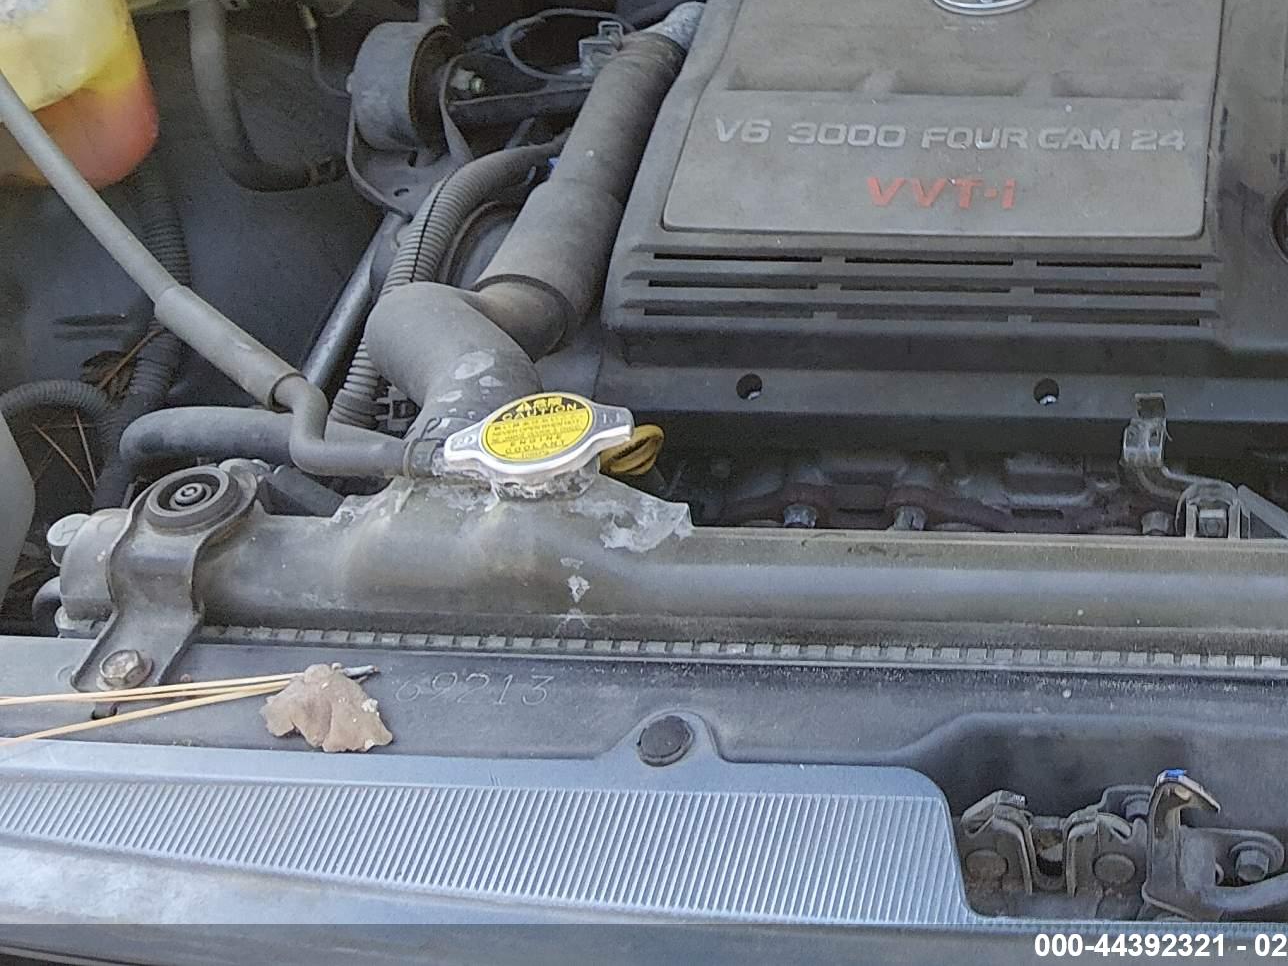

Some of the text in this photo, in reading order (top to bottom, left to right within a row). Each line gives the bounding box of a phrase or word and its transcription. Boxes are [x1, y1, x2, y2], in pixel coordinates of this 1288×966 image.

[714, 117, 1187, 152] V6 3000 FOUR CAM 24
[502, 402, 578, 421] CAUTION
